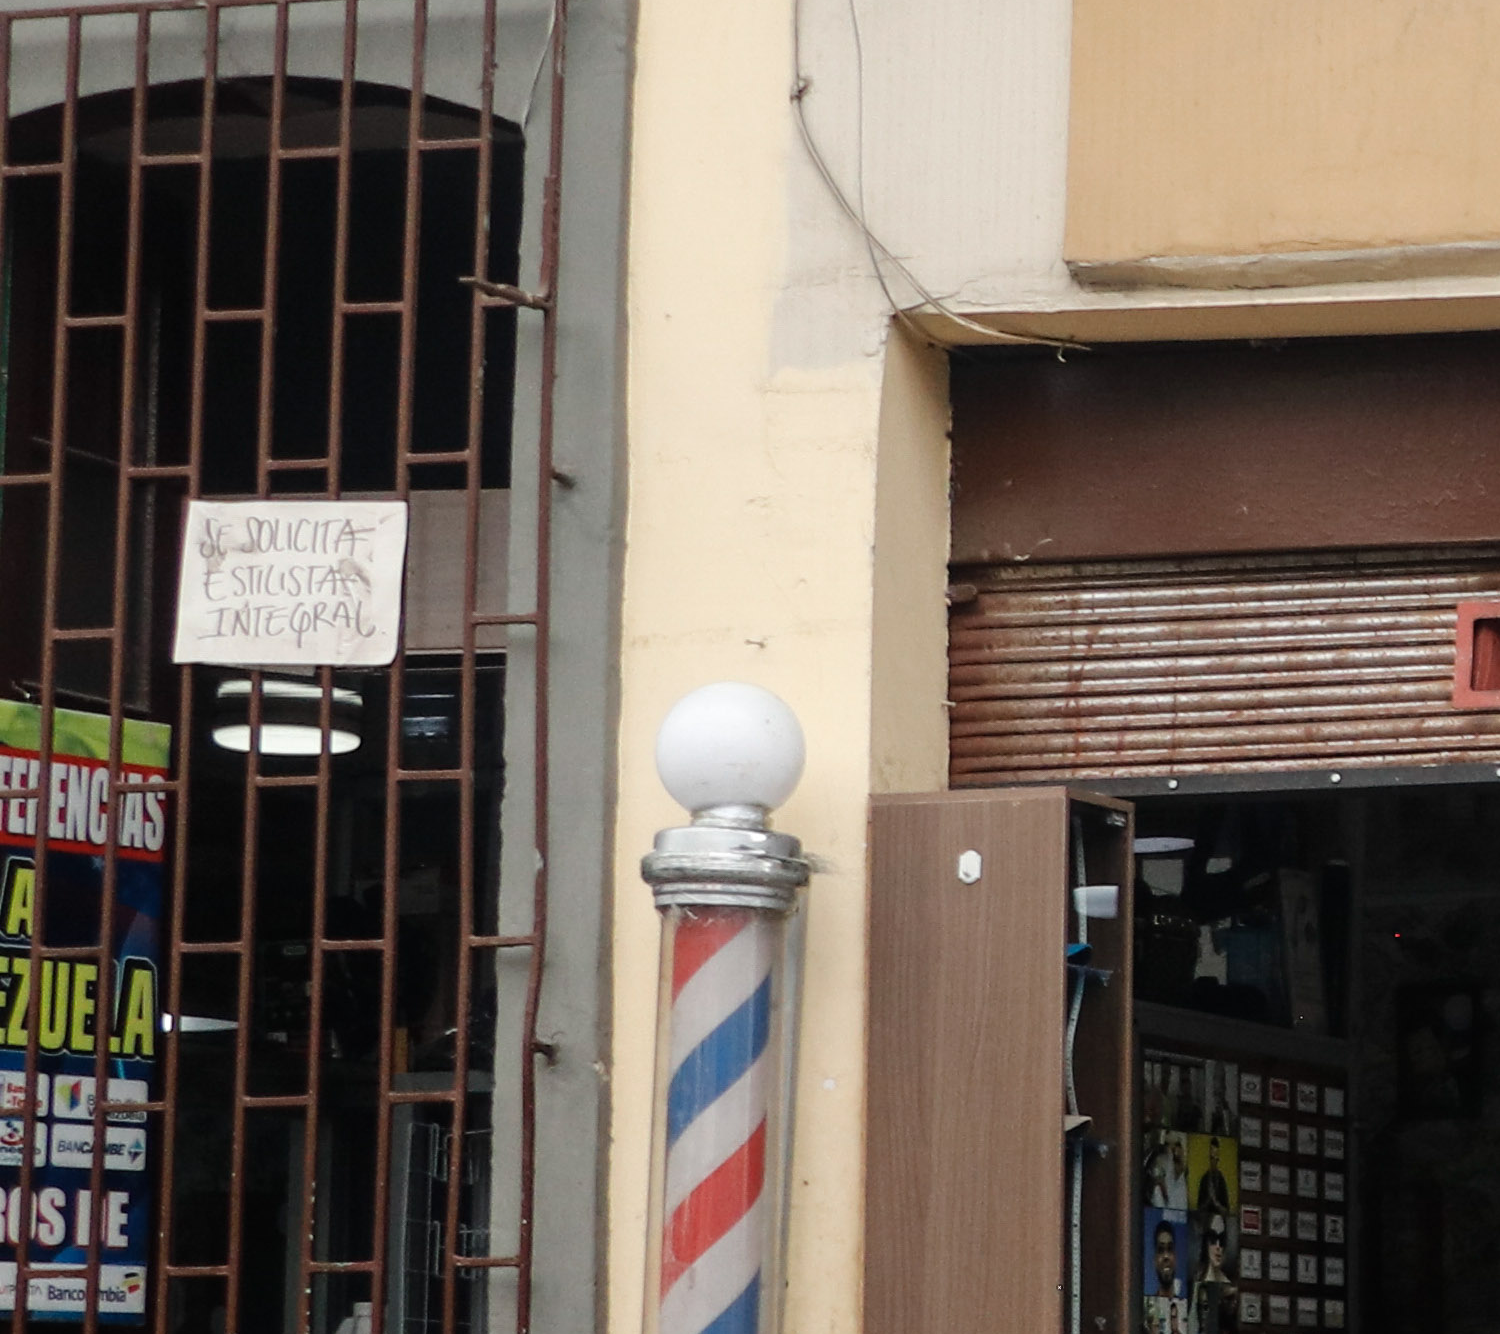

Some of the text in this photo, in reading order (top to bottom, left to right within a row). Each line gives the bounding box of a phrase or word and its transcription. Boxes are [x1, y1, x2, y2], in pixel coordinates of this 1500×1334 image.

[200, 516, 376, 558] SE SOLICITA
[203, 565, 358, 602] ESTILISTA
[0, 957, 155, 1057] ZUEA
[0, 1185, 66, 1246] OS
[48, 1284, 126, 1303] Bancombia
